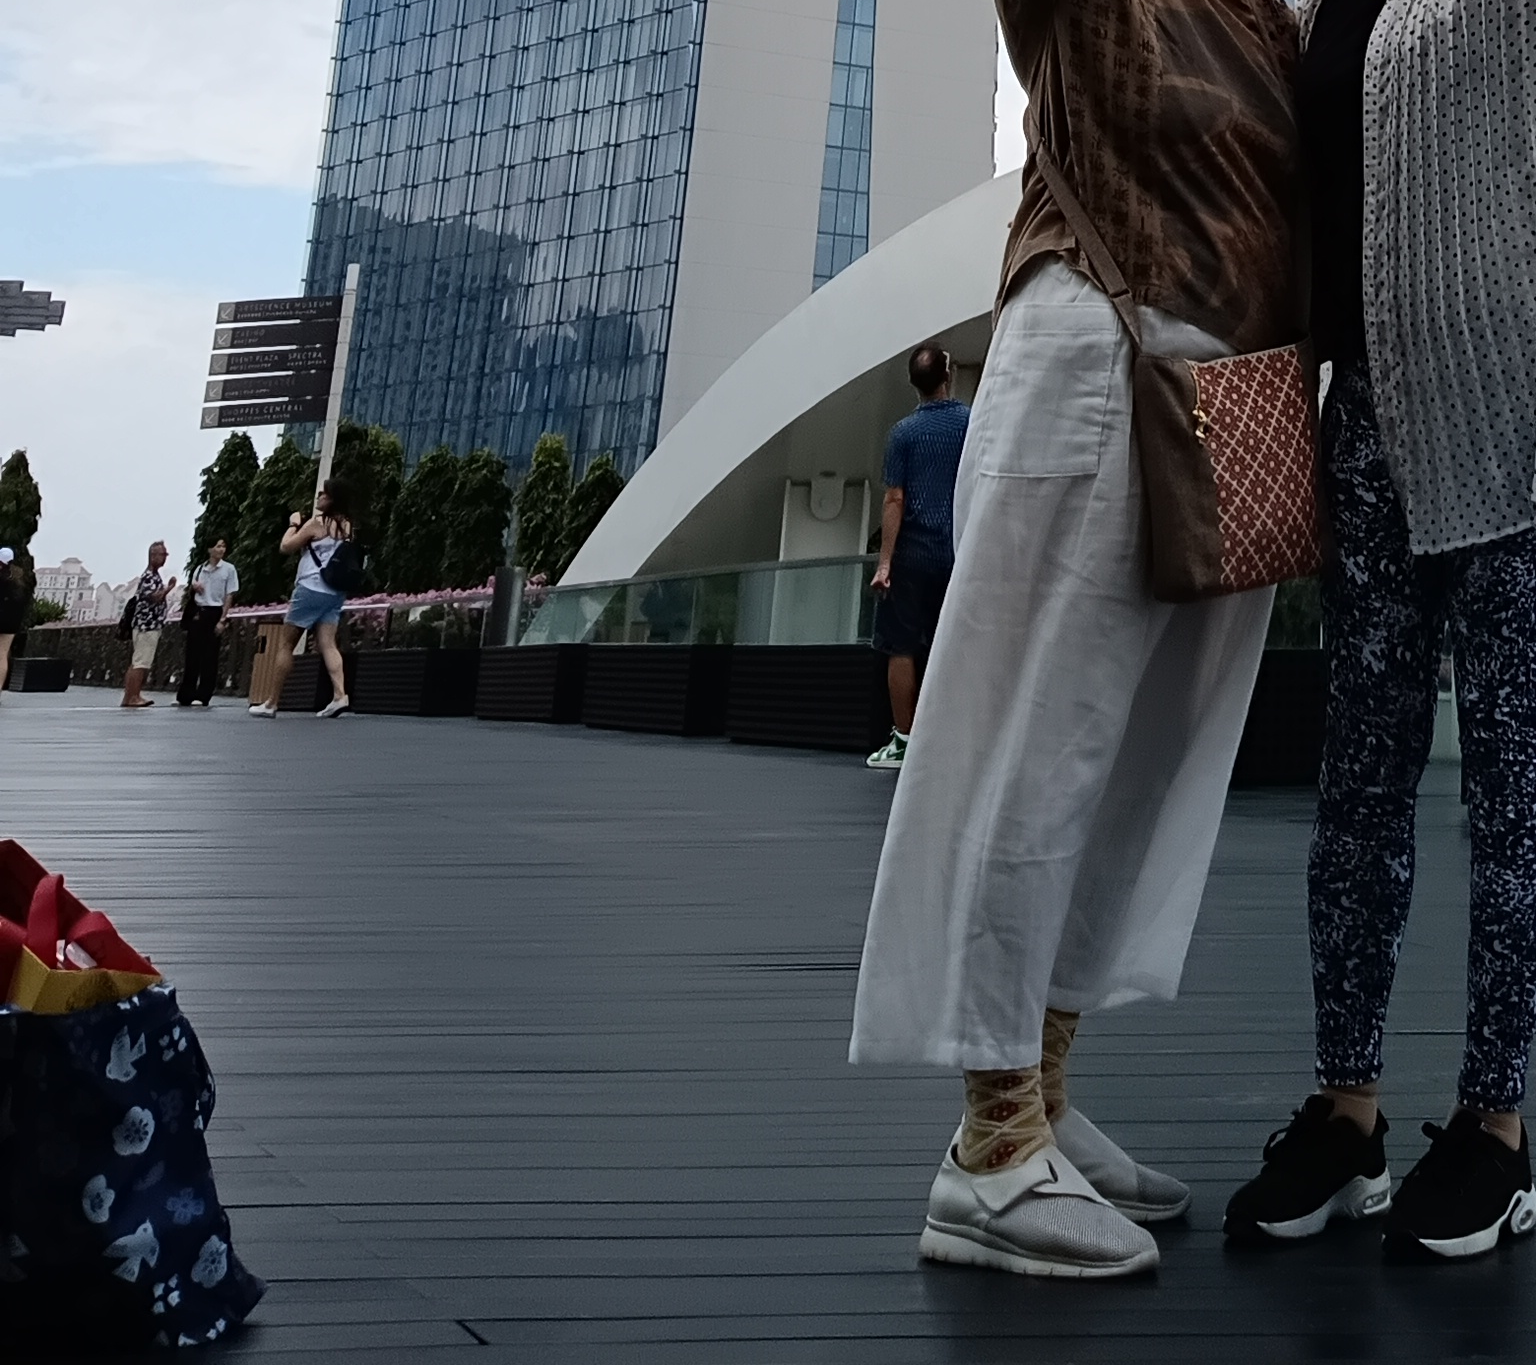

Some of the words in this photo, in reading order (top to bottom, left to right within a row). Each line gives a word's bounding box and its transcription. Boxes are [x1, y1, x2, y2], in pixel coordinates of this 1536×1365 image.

[294, 300, 333, 309] MUSEUM
[255, 354, 279, 362] PLAZA
[287, 351, 322, 360] SPECTRA
[262, 404, 303, 414] CENTRAL
